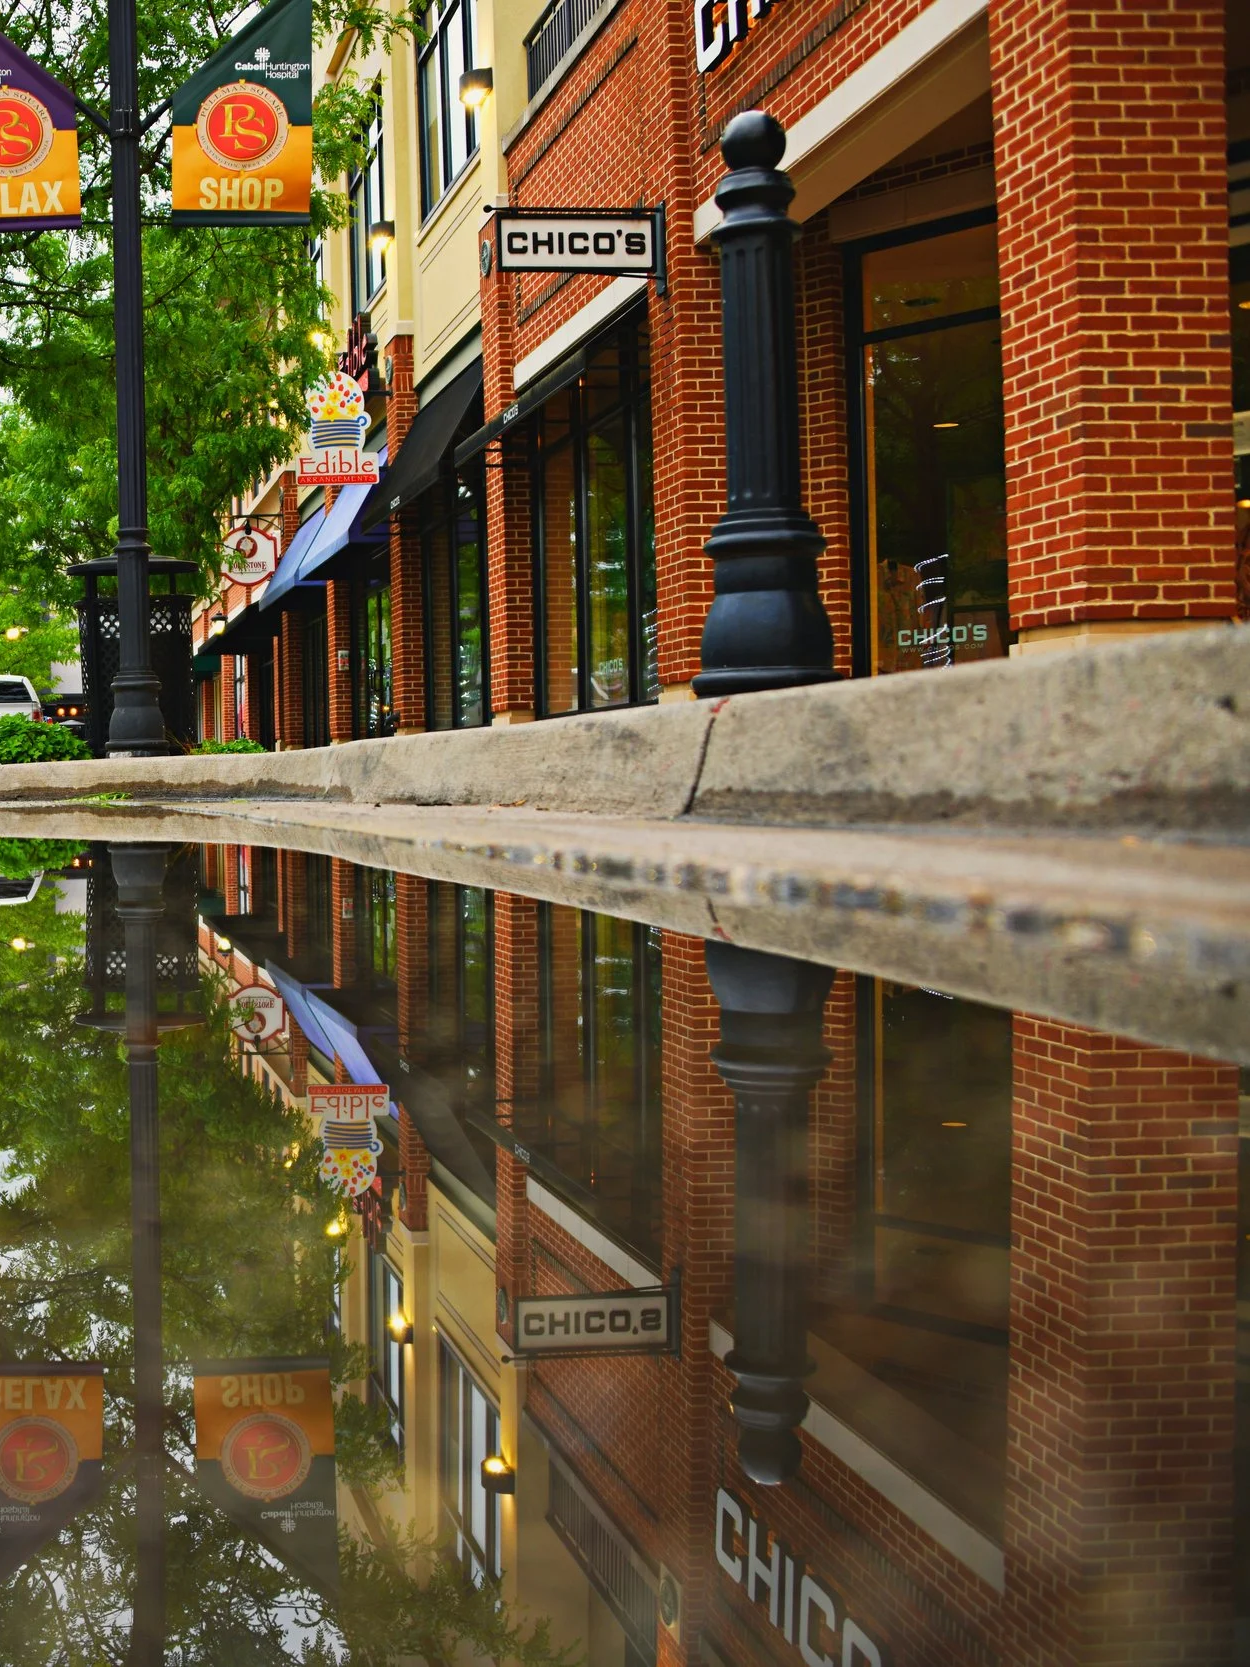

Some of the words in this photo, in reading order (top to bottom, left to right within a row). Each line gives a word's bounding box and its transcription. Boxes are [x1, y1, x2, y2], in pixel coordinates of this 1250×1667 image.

[265, 62, 310, 72] Huntington
[265, 70, 299, 80] Hospital
[13, 91, 49, 123] SQUARE
[200, 84, 248, 118] PULLMAN
[250, 85, 285, 118] SQUARE
[199, 176, 284, 210] SHOP
[507, 229, 646, 255] CHICO'S
[299, 450, 374, 474] Edible
[300, 475, 375, 484] ARRANGEMENTS
[898, 623, 988, 646] CHICO'S
